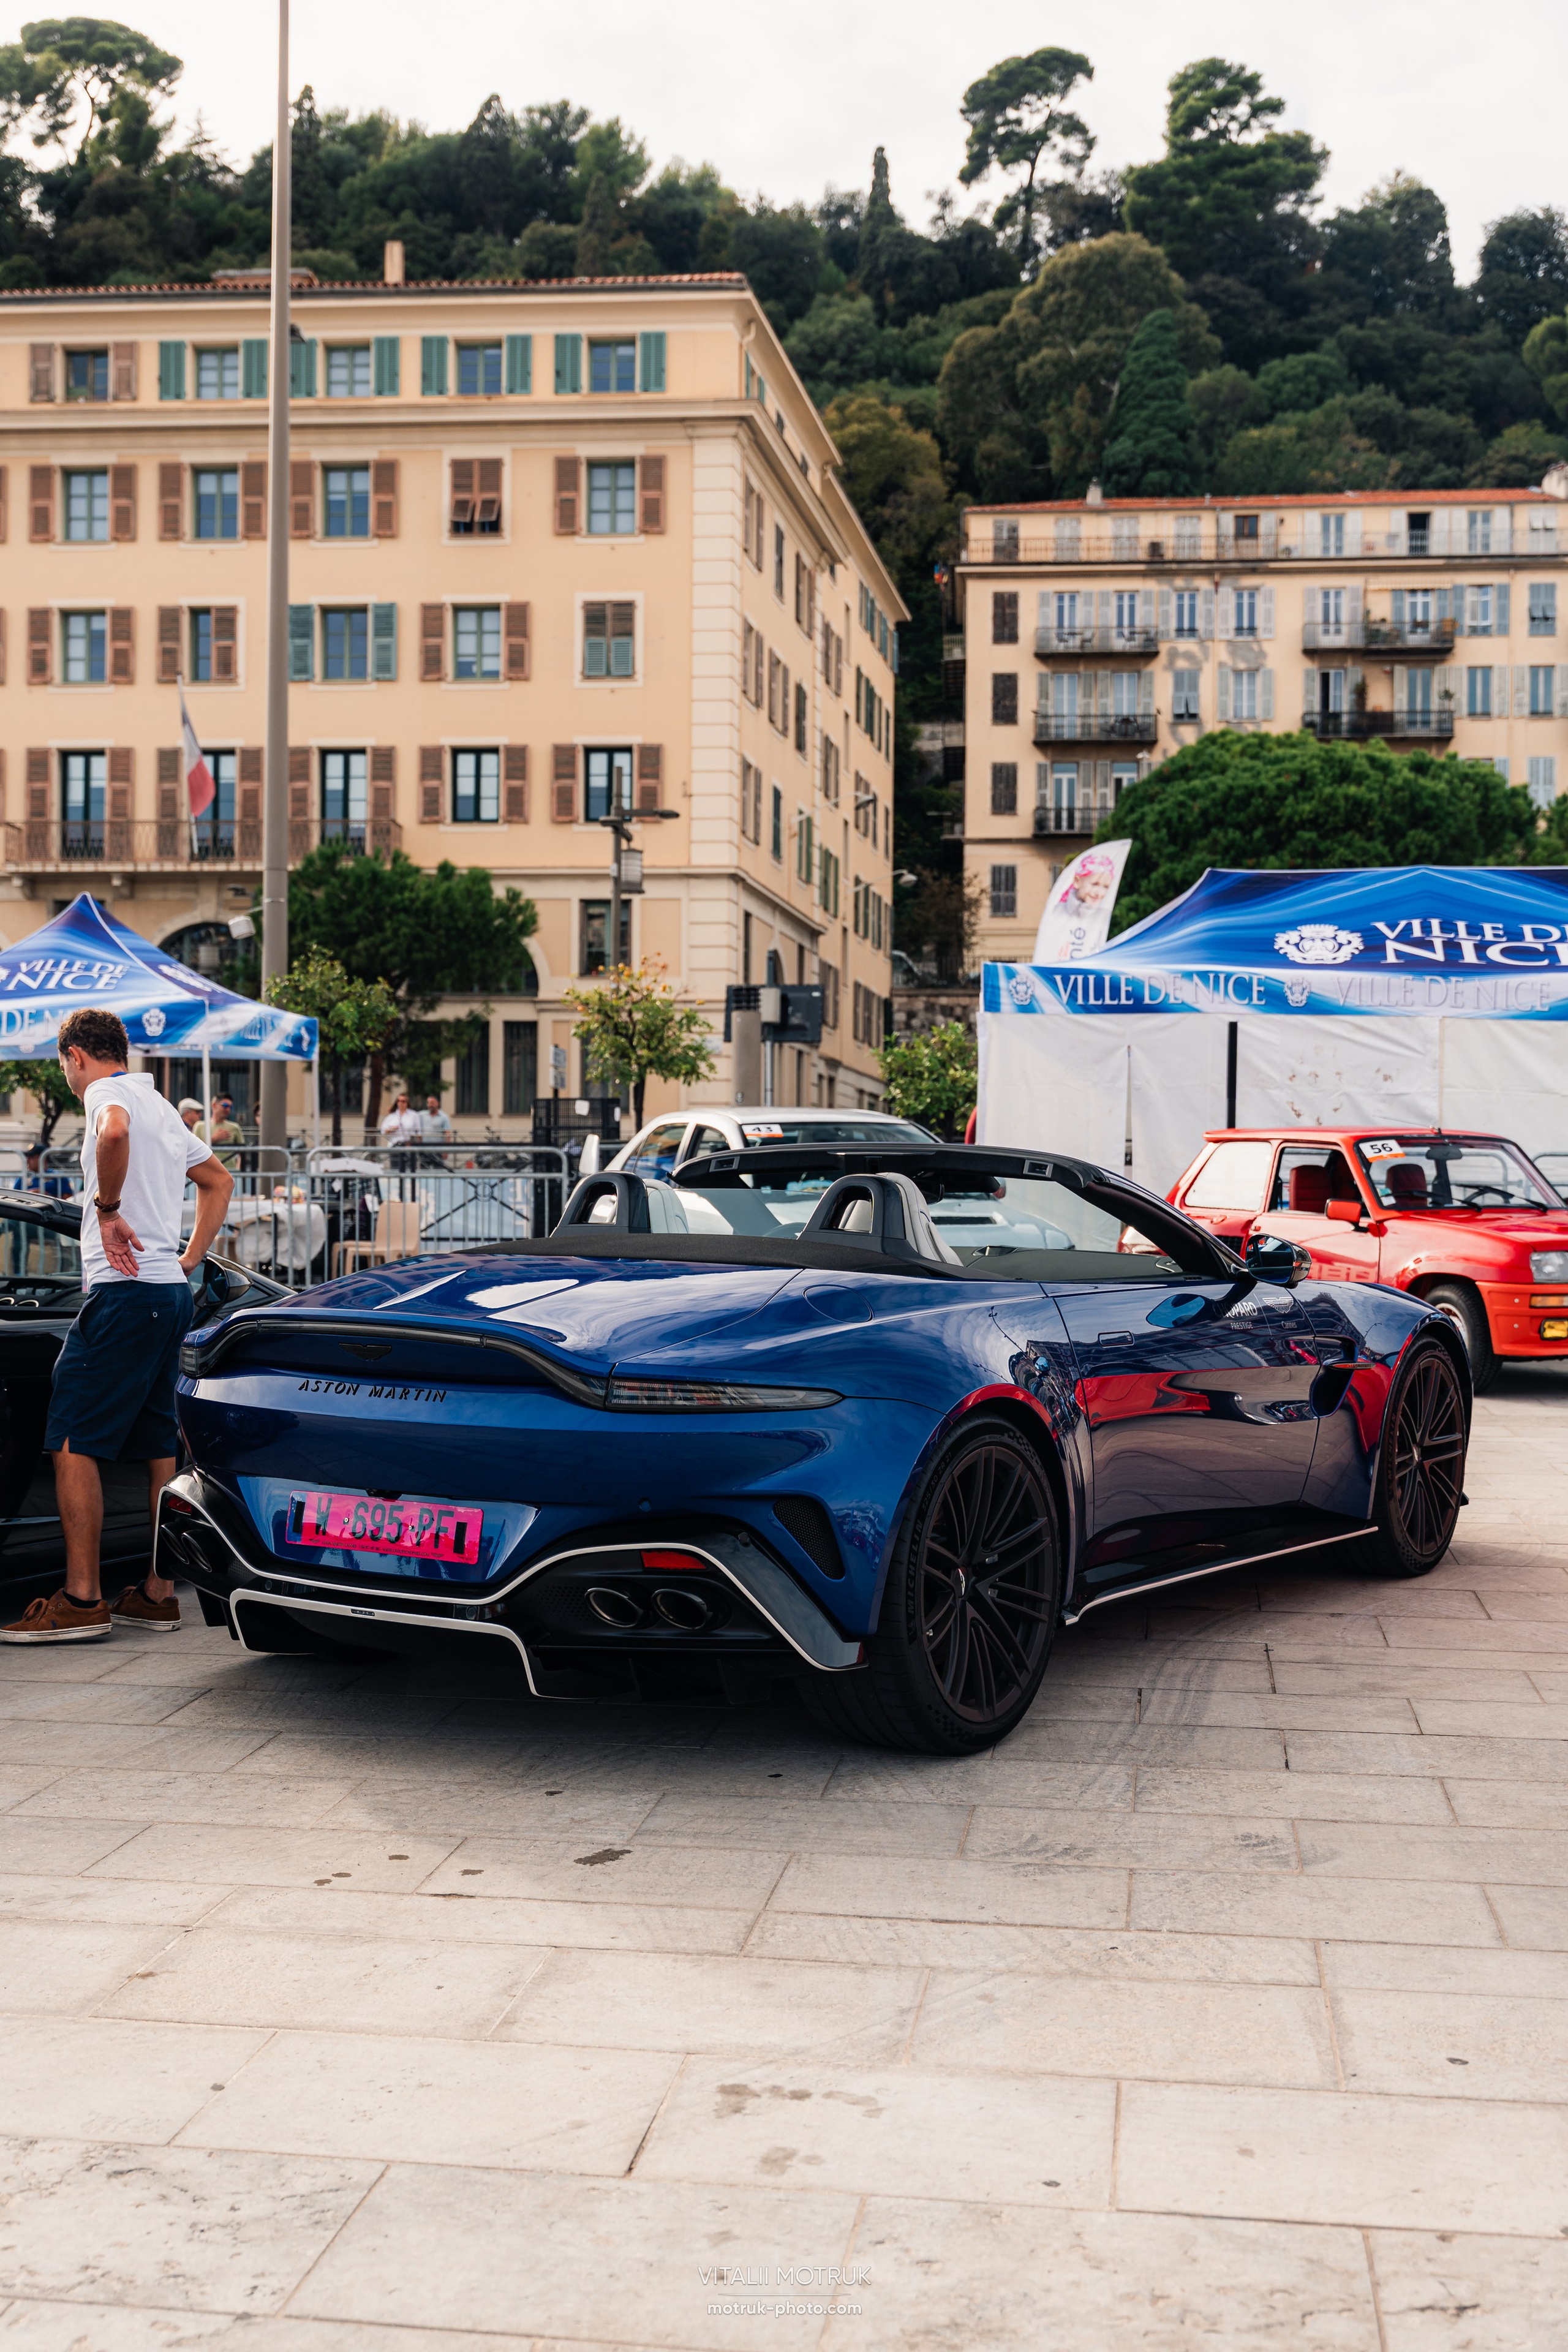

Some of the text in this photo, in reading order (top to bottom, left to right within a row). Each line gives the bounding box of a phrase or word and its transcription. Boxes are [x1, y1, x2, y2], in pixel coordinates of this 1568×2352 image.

[1370, 918, 1567, 943] VILLE D
[20, 958, 130, 974] VILLE DE
[4, 971, 123, 990] NICE
[1053, 973, 1266, 1005] VILLE DE NICE
[1332, 976, 1551, 1012] VILLE DE NICE
[0, 1009, 37, 1037] DE
[1370, 1143, 1393, 1153] 56
[1231, 1321, 1254, 1330] PRESTIGE
[1281, 1321, 1297, 1330] Cannes
[298, 1379, 448, 1403] ASTON MARTIN
[907, 1520, 923, 1615] MICHELIN
[921, 1474, 938, 1512] 325/30
